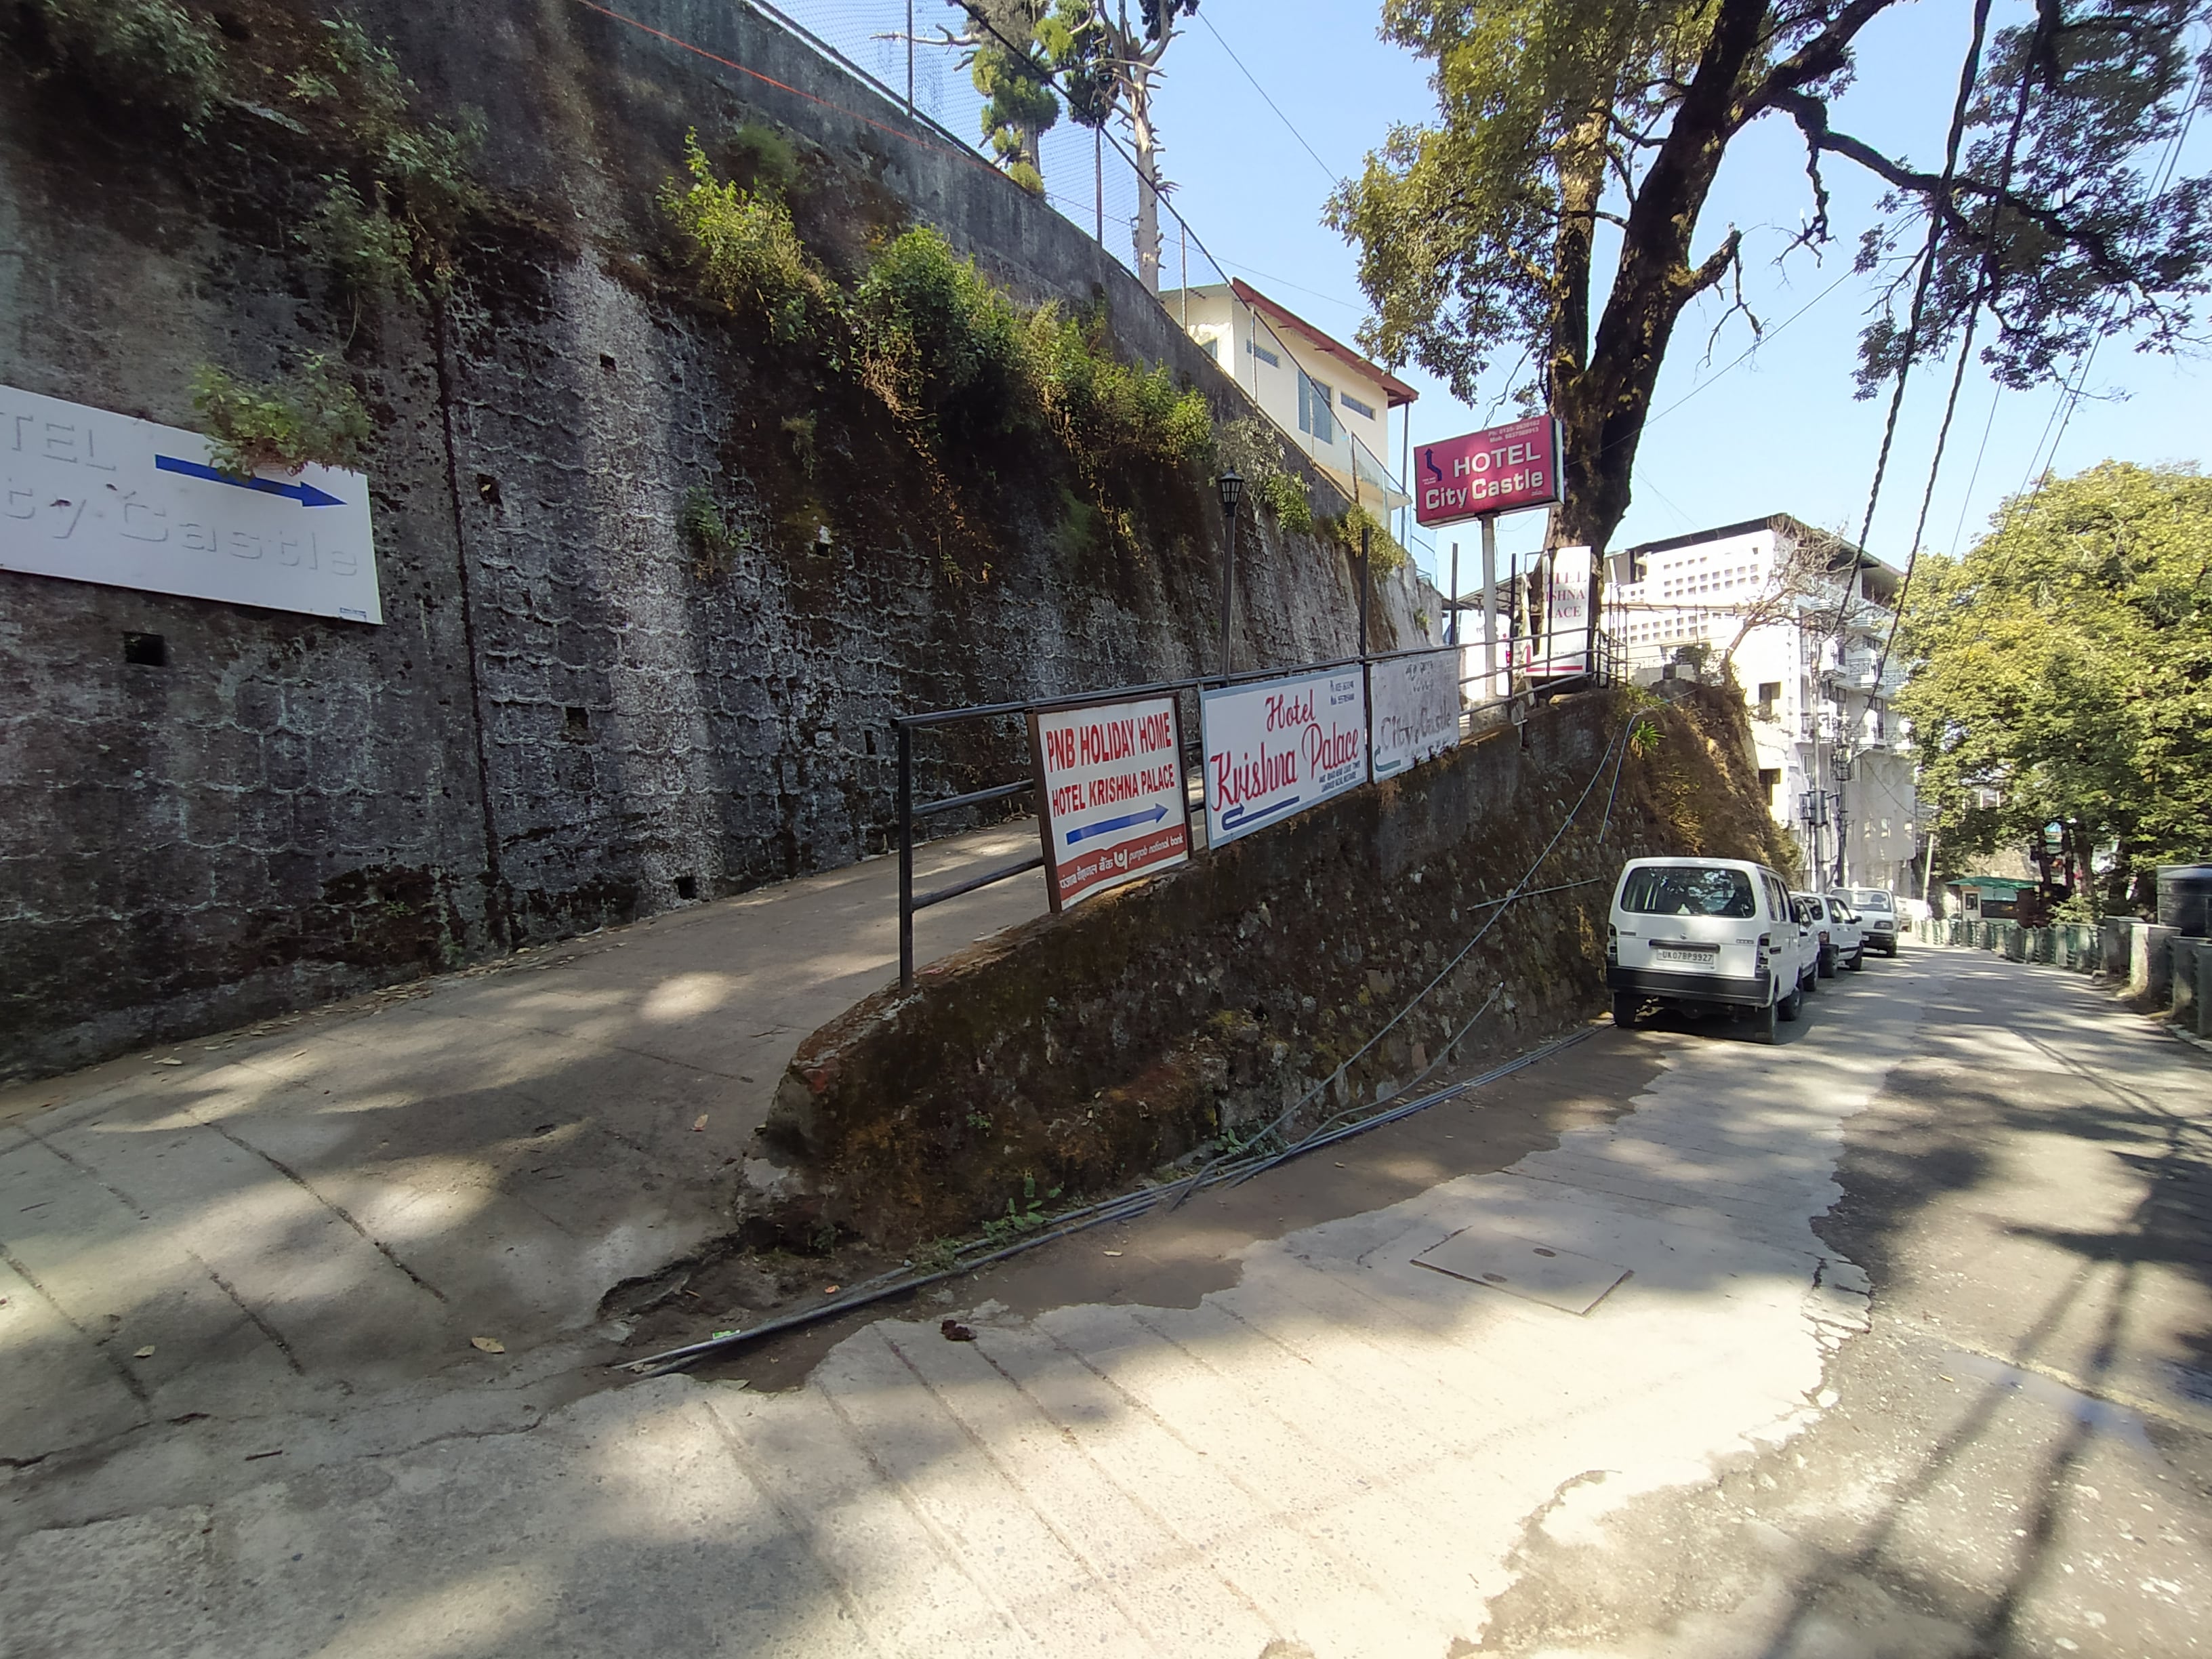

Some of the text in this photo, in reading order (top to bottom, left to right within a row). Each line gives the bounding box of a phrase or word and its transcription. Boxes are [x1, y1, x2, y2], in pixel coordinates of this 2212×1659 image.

[1454, 442, 1541, 477] HOTEL
[1425, 468, 1543, 510] City Castle
[1265, 689, 1316, 732] Hotel
[1046, 712, 1172, 773] PNB HOLIDAY HOME
[1209, 722, 1358, 811] Krishna Palace
[1052, 763, 1174, 817] HOTEL KRISHNA PALACE
[1170, 833, 1183, 846] bank
